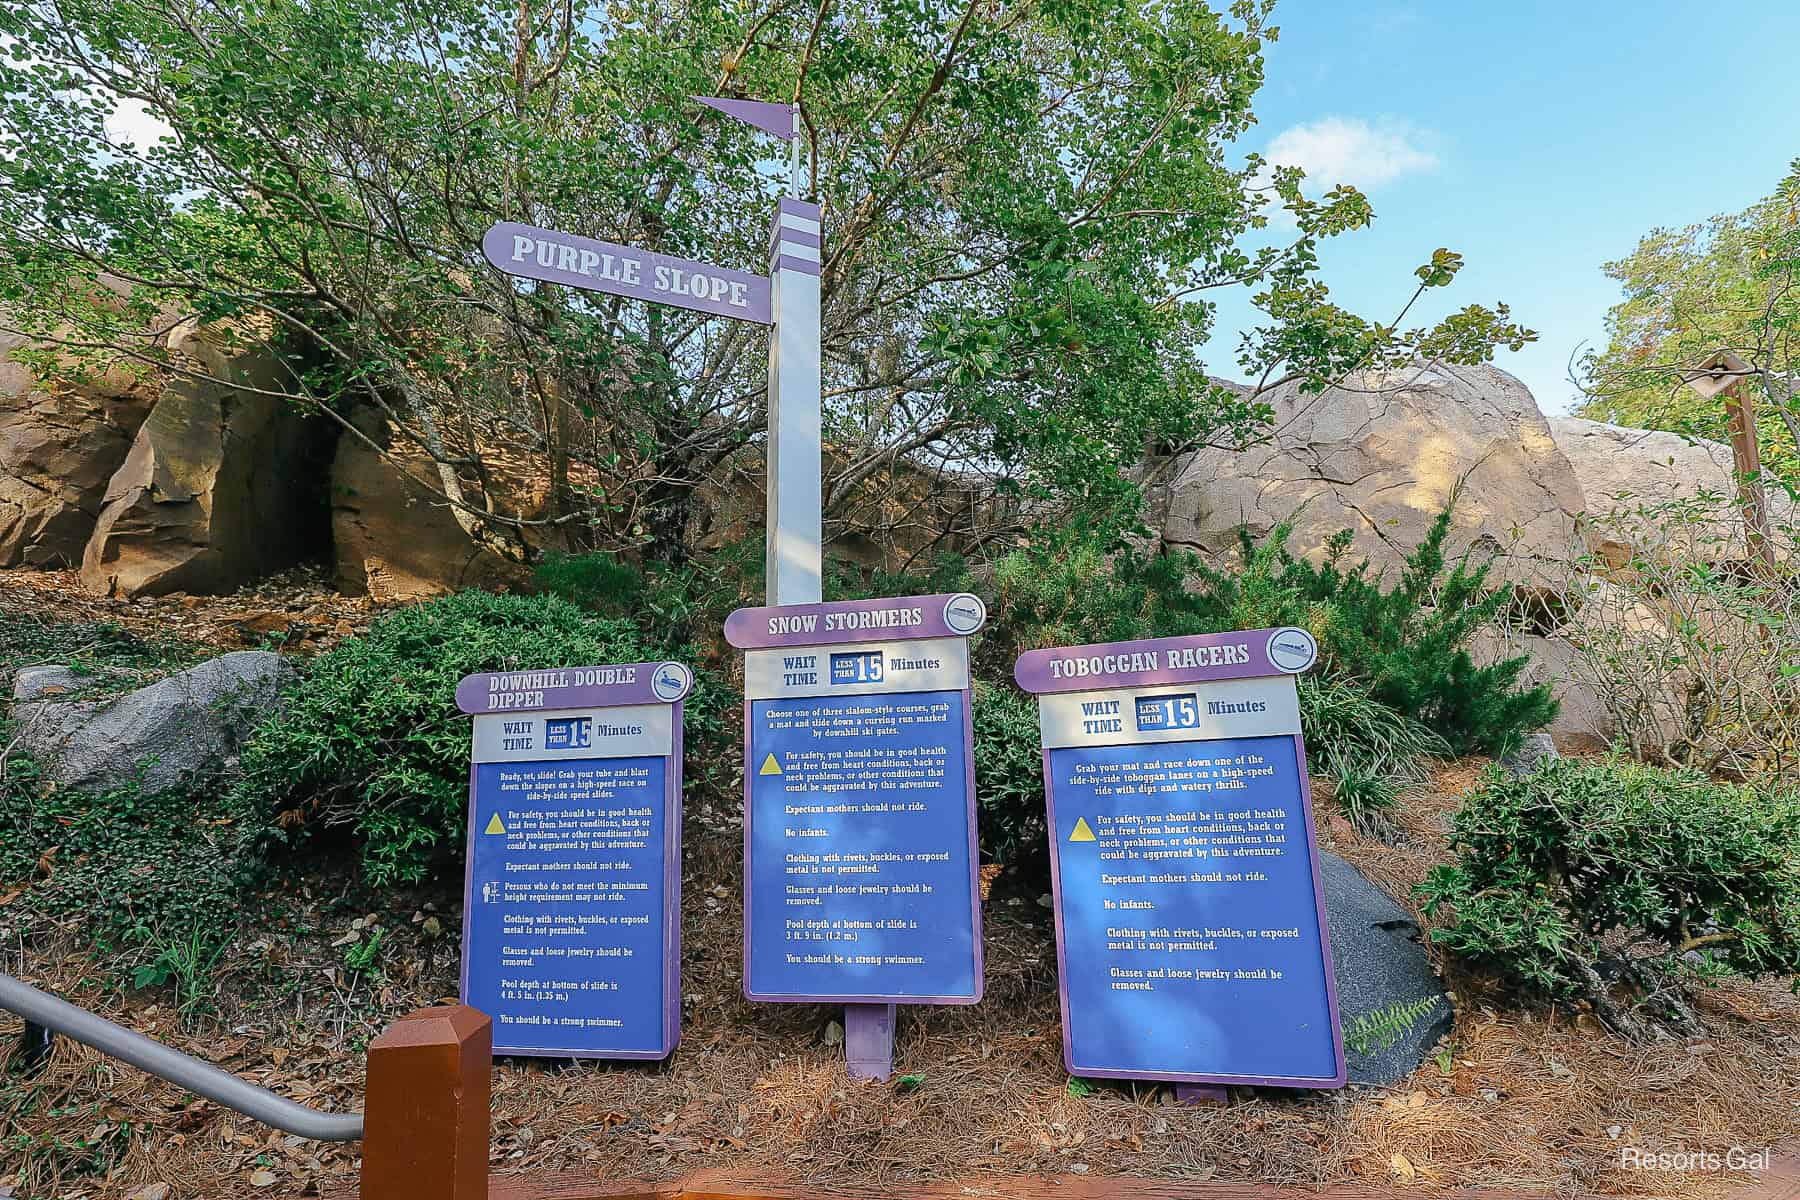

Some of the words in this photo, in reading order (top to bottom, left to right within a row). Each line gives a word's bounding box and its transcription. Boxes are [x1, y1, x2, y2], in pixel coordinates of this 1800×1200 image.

[512, 236, 640, 285] PURPLE
[655, 266, 748, 308] SLOPE
[769, 615, 817, 634] SNOW
[825, 608, 922, 631] STORMERS
[784, 656, 816, 669] WAIT
[835, 660, 853, 668] LESS
[1050, 651, 1159, 678] TOBOGGAN
[1168, 644, 1250, 669] RACERS
[835, 669, 854, 678] THAN
[857, 656, 881, 680] 15
[891, 658, 939, 671] Minutes
[489, 672, 569, 692] DOWNHILL
[575, 668, 636, 687] DOUBLE
[784, 673, 817, 685] TIME
[488, 692, 543, 709] DIPPER
[812, 708, 820, 717] of
[823, 707, 842, 716] three
[846, 706, 892, 716] slalom-style
[896, 705, 928, 713] courses,
[931, 703, 949, 713] grab
[1082, 701, 1120, 716] WAIT
[1139, 704, 1160, 714] LESS
[1165, 699, 1196, 726] 15
[1208, 700, 1266, 714] Minutes
[777, 720, 791, 728] mat
[795, 719, 808, 727] and
[812, 719, 830, 727] slide
[833, 718, 853, 726] down
[865, 717, 895, 726] curving
[917, 714, 947, 722] marked
[1139, 715, 1162, 724] THAN
[504, 722, 533, 734] WAIT
[813, 728, 821, 739] by
[825, 728, 858, 736] downhill
[862, 727, 873, 735] ski
[877, 727, 899, 736] gates.
[1084, 719, 1122, 734] TIME
[570, 721, 591, 747] 15
[598, 725, 642, 737] Minutes
[504, 738, 533, 750] TIME
[1076, 764, 1096, 772] Grab
[1100, 764, 1119, 774] your
[1123, 762, 1140, 771] mat
[1144, 760, 1159, 770] and
[1164, 760, 1183, 768] race
[1187, 758, 1210, 768] down
[1215, 758, 1231, 766] one
[1235, 756, 1245, 765] of
[1248, 755, 1263, 764] the
[1070, 775, 1120, 785] side-by-side
[1124, 773, 1165, 783] toboggan
[1169, 771, 1193, 780] lanes
[1222, 766, 1273, 777] high-speed
[1096, 787, 1112, 795] ride
[1116, 786, 1135, 794] with
[1139, 784, 1156, 795] dips
[1161, 783, 1177, 792] and
[1181, 783, 1212, 792] watery
[1216, 780, 1247, 789] thrills.
[785, 806, 823, 815] Expectant
[861, 804, 888, 812] should
[908, 802, 927, 810] ride.
[1098, 815, 1111, 824] For
[1115, 814, 1143, 825] safety,
[1146, 814, 1161, 824] you
[1166, 812, 1196, 822] should
[1200, 812, 1210, 820] be
[1215, 811, 1224, 819] in
[1228, 811, 1250, 820] good
[1255, 809, 1285, 818] health
[800, 828, 829, 836] infants.
[1119, 826, 1135, 835] free
[1140, 825, 1161, 834] from
[1164, 824, 1189, 834] heart
[1193, 822, 1245, 833] conditions,
[1248, 822, 1270, 831] back
[1275, 822, 1284, 830] or
[1100, 839, 1120, 847] neck
[1124, 838, 1168, 849] problems,
[1184, 837, 1208, 845] other
[1212, 836, 1261, 844] conditions
[1265, 835, 1285, 843] that
[1101, 851, 1125, 859] could
[1129, 850, 1139, 859] be
[1143, 849, 1193, 860] aggravated
[1197, 849, 1207, 859] by
[1212, 848, 1228, 856] this
[1233, 848, 1284, 856] adventure.
[1103, 875, 1146, 885] Expectant
[1150, 874, 1186, 882] mothers
[1191, 872, 1222, 881] should
[1226, 873, 1241, 881] not
[1246, 872, 1268, 880] ride.
[505, 882, 531, 890] Persons
[534, 882, 548, 890] who
[551, 882, 560, 890] do
[504, 893, 526, 902] height
[530, 894, 572, 902] requirement
[1104, 900, 1116, 909] No
[1120, 899, 1154, 909] infants.
[504, 915, 533, 924] Clothing
[555, 916, 576, 924] rivets,
[579, 915, 608, 924] buckles,
[620, 915, 648, 925] exposed
[504, 926, 523, 934] metal
[527, 926, 532, 934] is
[550, 926, 587, 936] permitted.
[1108, 928, 1146, 939] Clothing
[1150, 928, 1169, 937] with
[1174, 928, 1202, 938] rivets,
[1205, 928, 1244, 938] buckles,
[1247, 929, 1257, 937] or
[1261, 928, 1299, 938] exposed
[1109, 941, 1133, 950] metal
[1138, 941, 1145, 949] is
[1150, 941, 1164, 949] not
[1168, 941, 1217, 952] permitted.
[1111, 968, 1143, 977] Glasses
[1147, 969, 1163, 978] and
[1168, 969, 1192, 978] loose
[1196, 969, 1230, 980] jewelry
[1234, 970, 1266, 979] should
[1271, 970, 1281, 979] be
[1112, 981, 1153, 990] removed.
